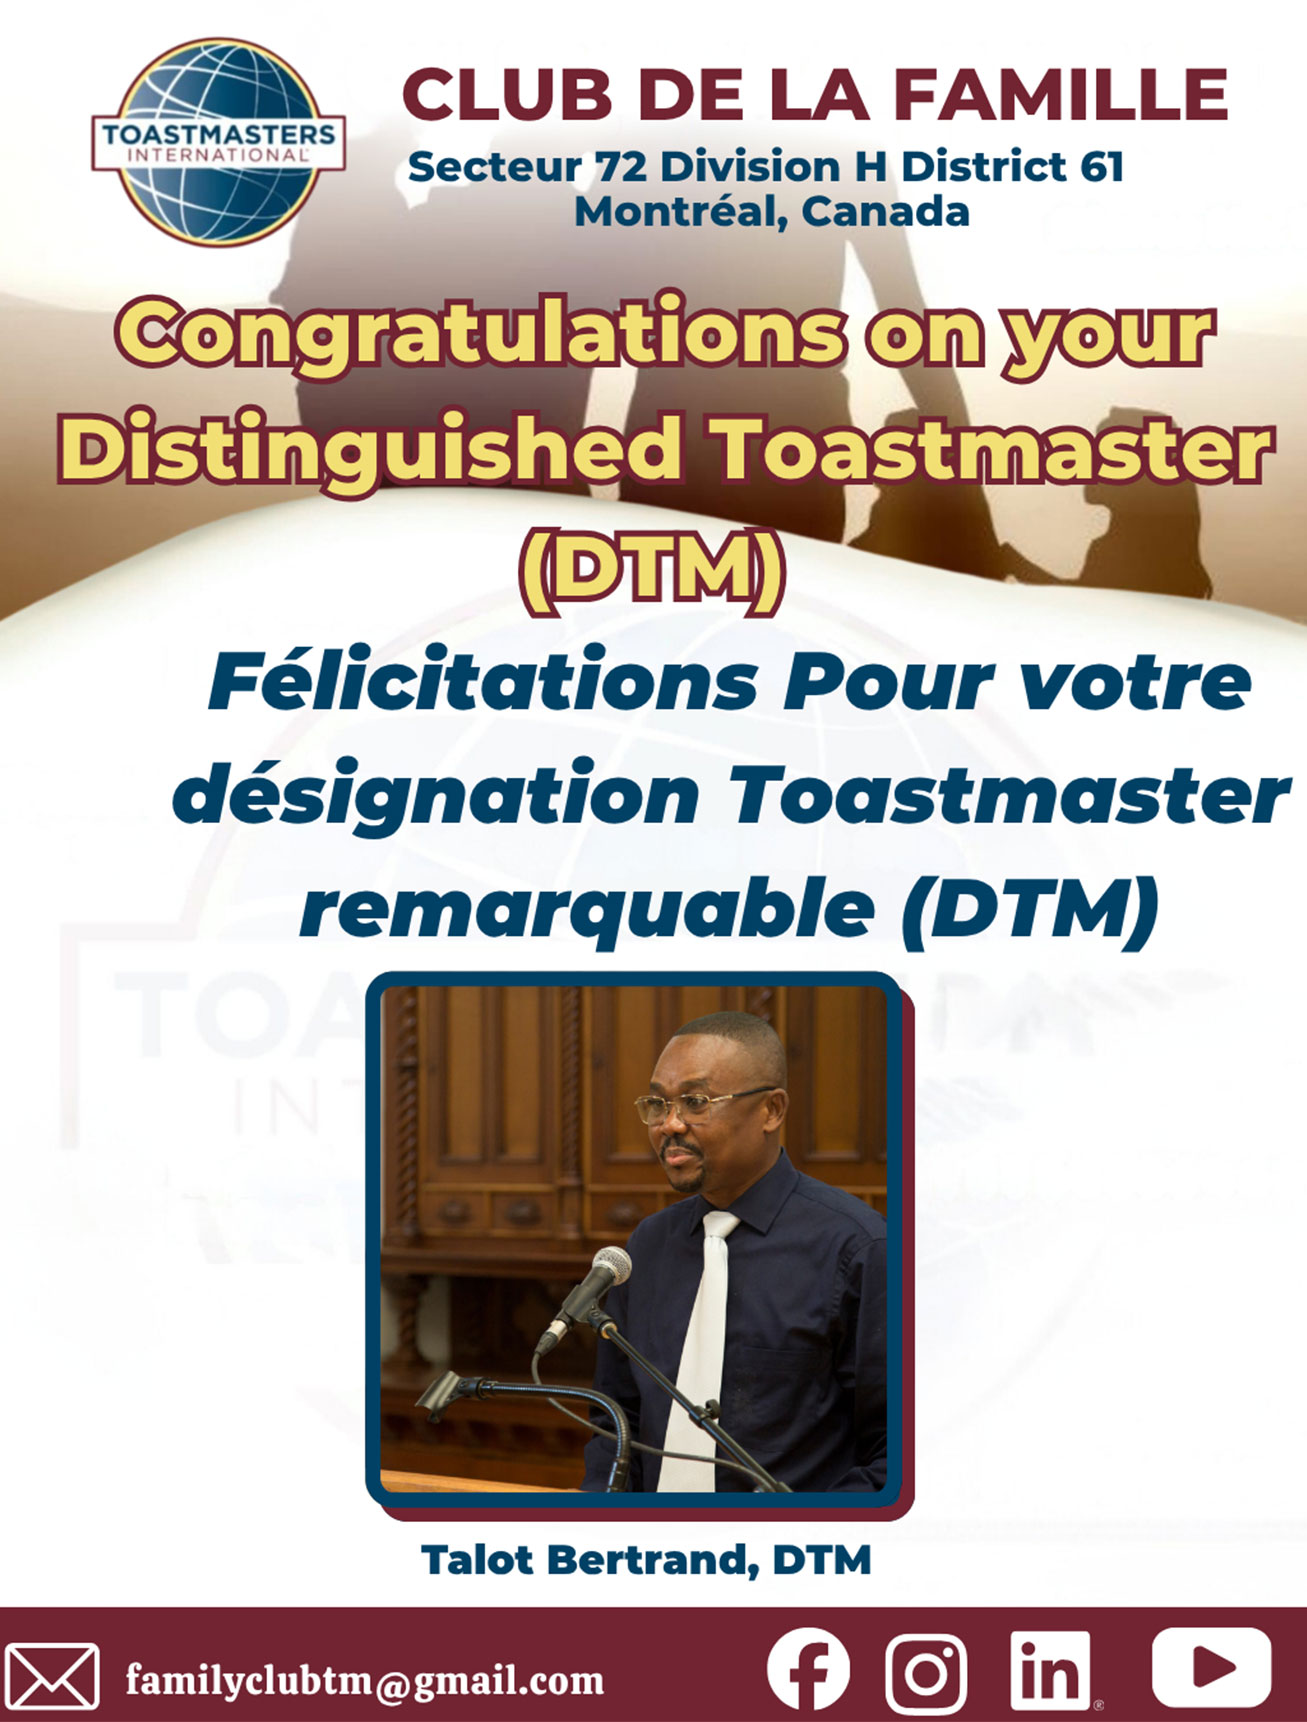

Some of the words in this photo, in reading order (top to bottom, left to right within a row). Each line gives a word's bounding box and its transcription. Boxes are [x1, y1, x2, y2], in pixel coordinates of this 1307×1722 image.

[404, 67, 612, 121] CLUB
[641, 68, 743, 121] DE
[772, 68, 871, 121] LA
[897, 68, 1228, 121] FAMILLE
[102, 124, 335, 145] TOASTMASTERS
[128, 148, 309, 162] INTERNATIONAL
[409, 150, 582, 182] Secteur
[596, 151, 647, 182] 72
[662, 148, 839, 182] Division
[857, 151, 886, 182] H
[903, 148, 1067, 182] District
[1081, 151, 1123, 182] 61
[576, 193, 788, 233] Montréal,
[802, 194, 970, 227] Canada
[114, 287, 848, 378] Congratulations
[865, 308, 985, 368] on
[999, 309, 1217, 384] your
[57, 409, 684, 497] Distinguished
[704, 412, 1277, 486] Toastmaster
[518, 529, 789, 619] (DTM)
[208, 642, 759, 711] Félicitations
[783, 651, 996, 711] Pour
[1020, 654, 1252, 711] votre
[172, 755, 699, 840] désignation
[730, 765, 1293, 824] Toastmaster
[299, 876, 875, 953] remarquable
[902, 875, 1158, 953] (DTM)
[421, 1543, 534, 1575] Talot
[548, 1543, 759, 1581] Bertrand,
[774, 1544, 873, 1575] DTM
[126, 1662, 605, 1707] familyclubtm@gmail.com
